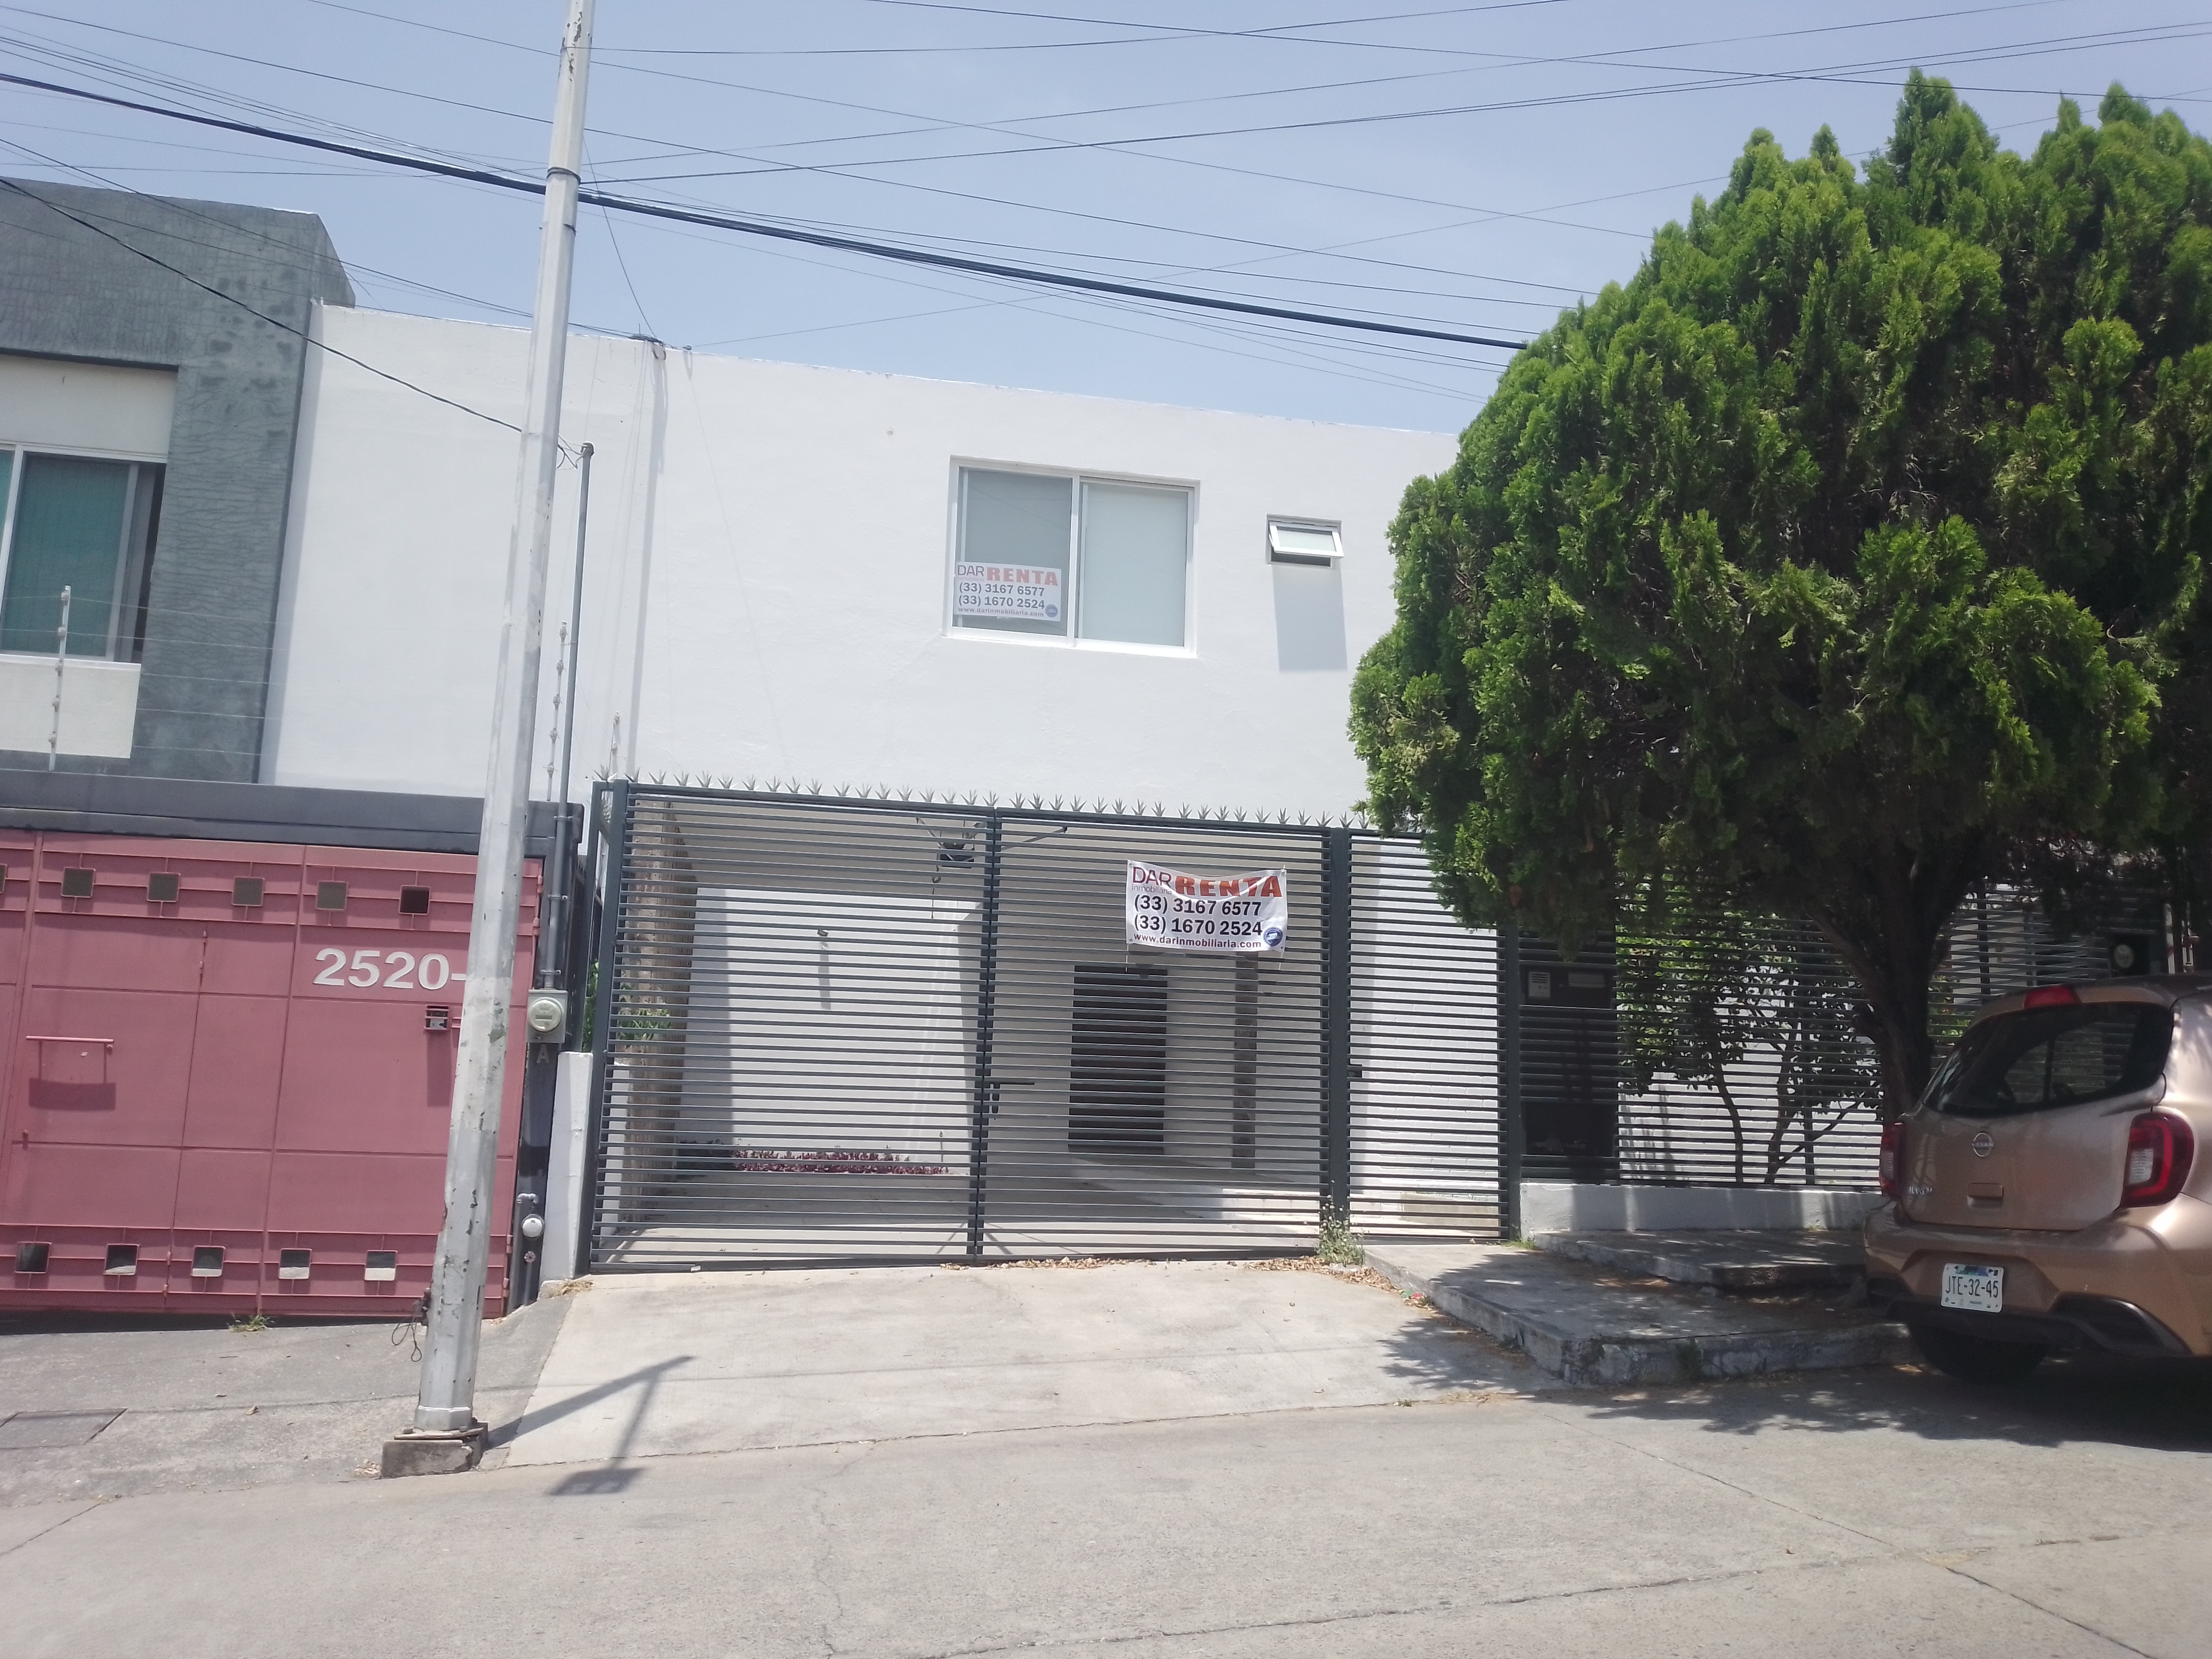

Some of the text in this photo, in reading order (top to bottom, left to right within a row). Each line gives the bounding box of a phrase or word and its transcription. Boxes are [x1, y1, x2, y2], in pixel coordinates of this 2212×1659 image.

[958, 565, 1058, 585] DAR RENTA
[959, 582, 1045, 596] (33) 3167 6577
[958, 607, 1044, 617] www.darinmobiliaria.com
[959, 595, 1045, 609] (33) 1670 2524
[1133, 866, 1282, 897] DAR RENTA
[1135, 894, 1261, 916] (33) 3167 6577
[1134, 915, 1263, 936] (33) 1670 2524
[1134, 934, 1261, 948] www.darinmobiliaria.com
[1945, 1275, 1999, 1298] JTE-32-45
